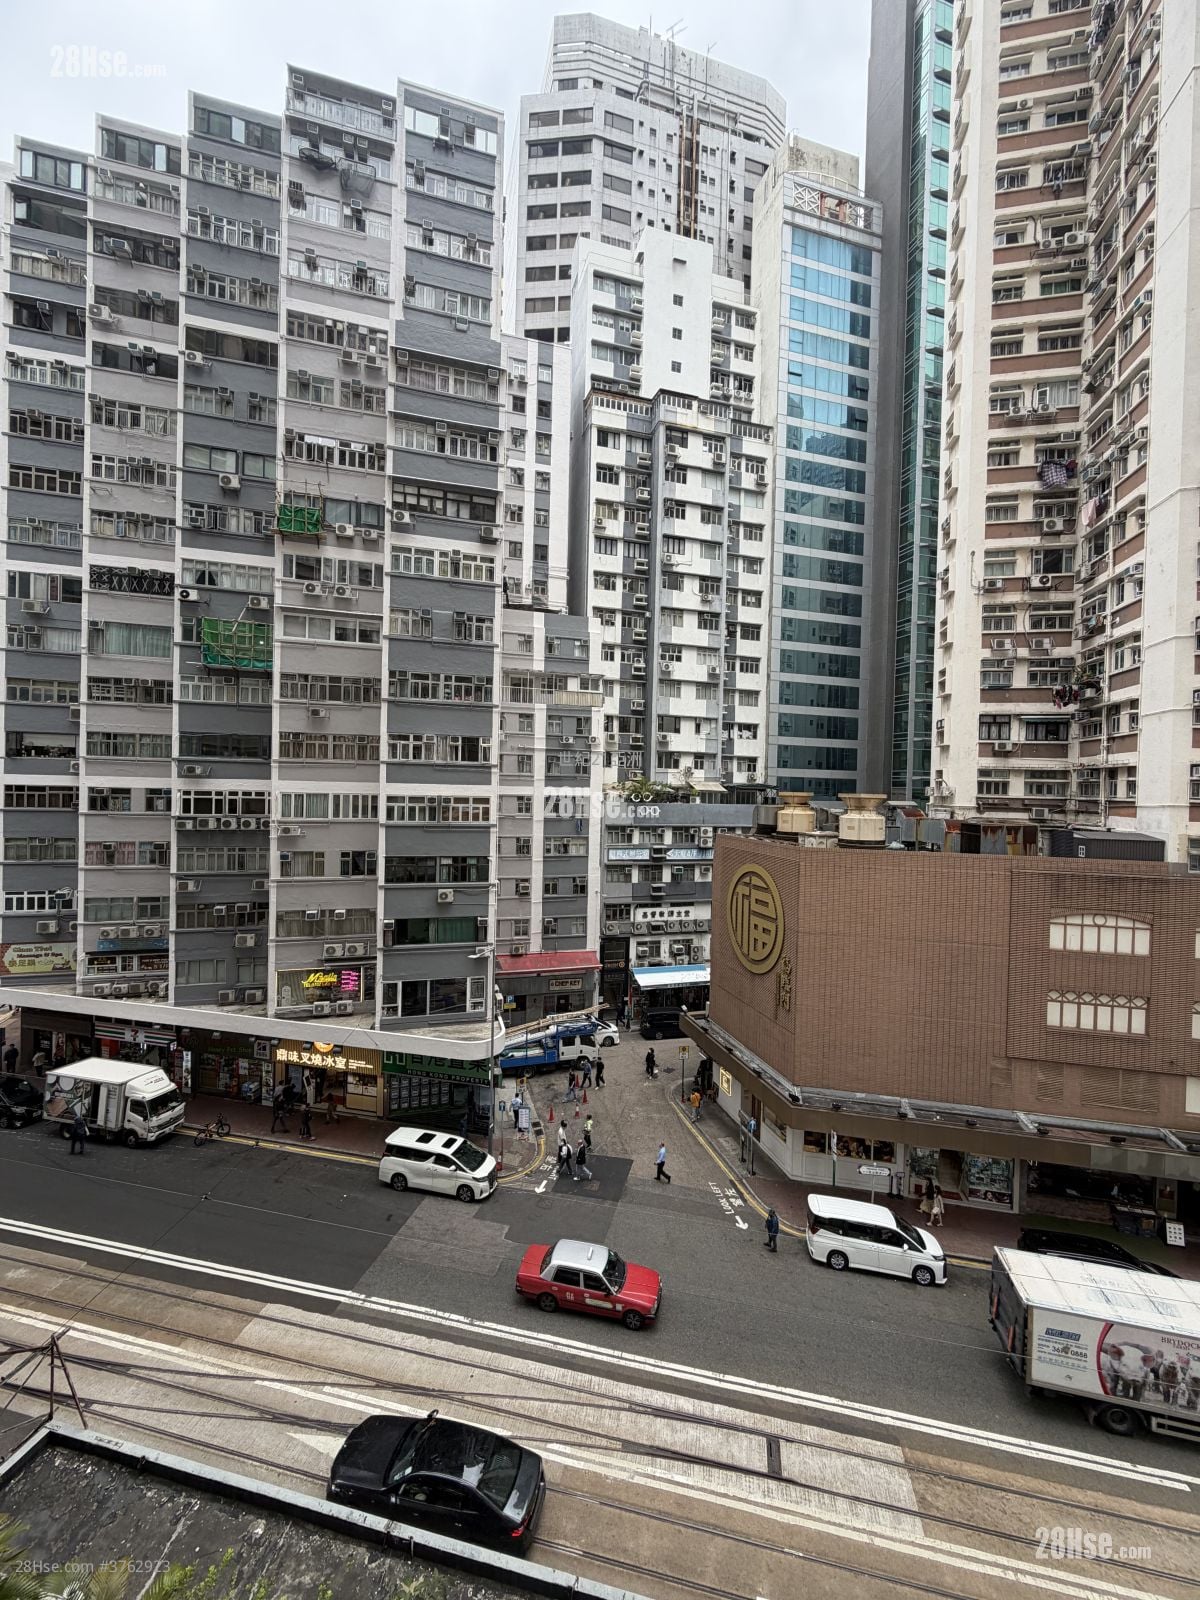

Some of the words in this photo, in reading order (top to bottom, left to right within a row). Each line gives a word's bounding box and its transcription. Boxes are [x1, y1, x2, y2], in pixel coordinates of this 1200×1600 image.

[429, 1072, 449, 1080] KONG
[451, 1076, 489, 1085] PROPERTY
[708, 1182, 723, 1197] LEFT
[718, 1198, 735, 1214] LOOK
